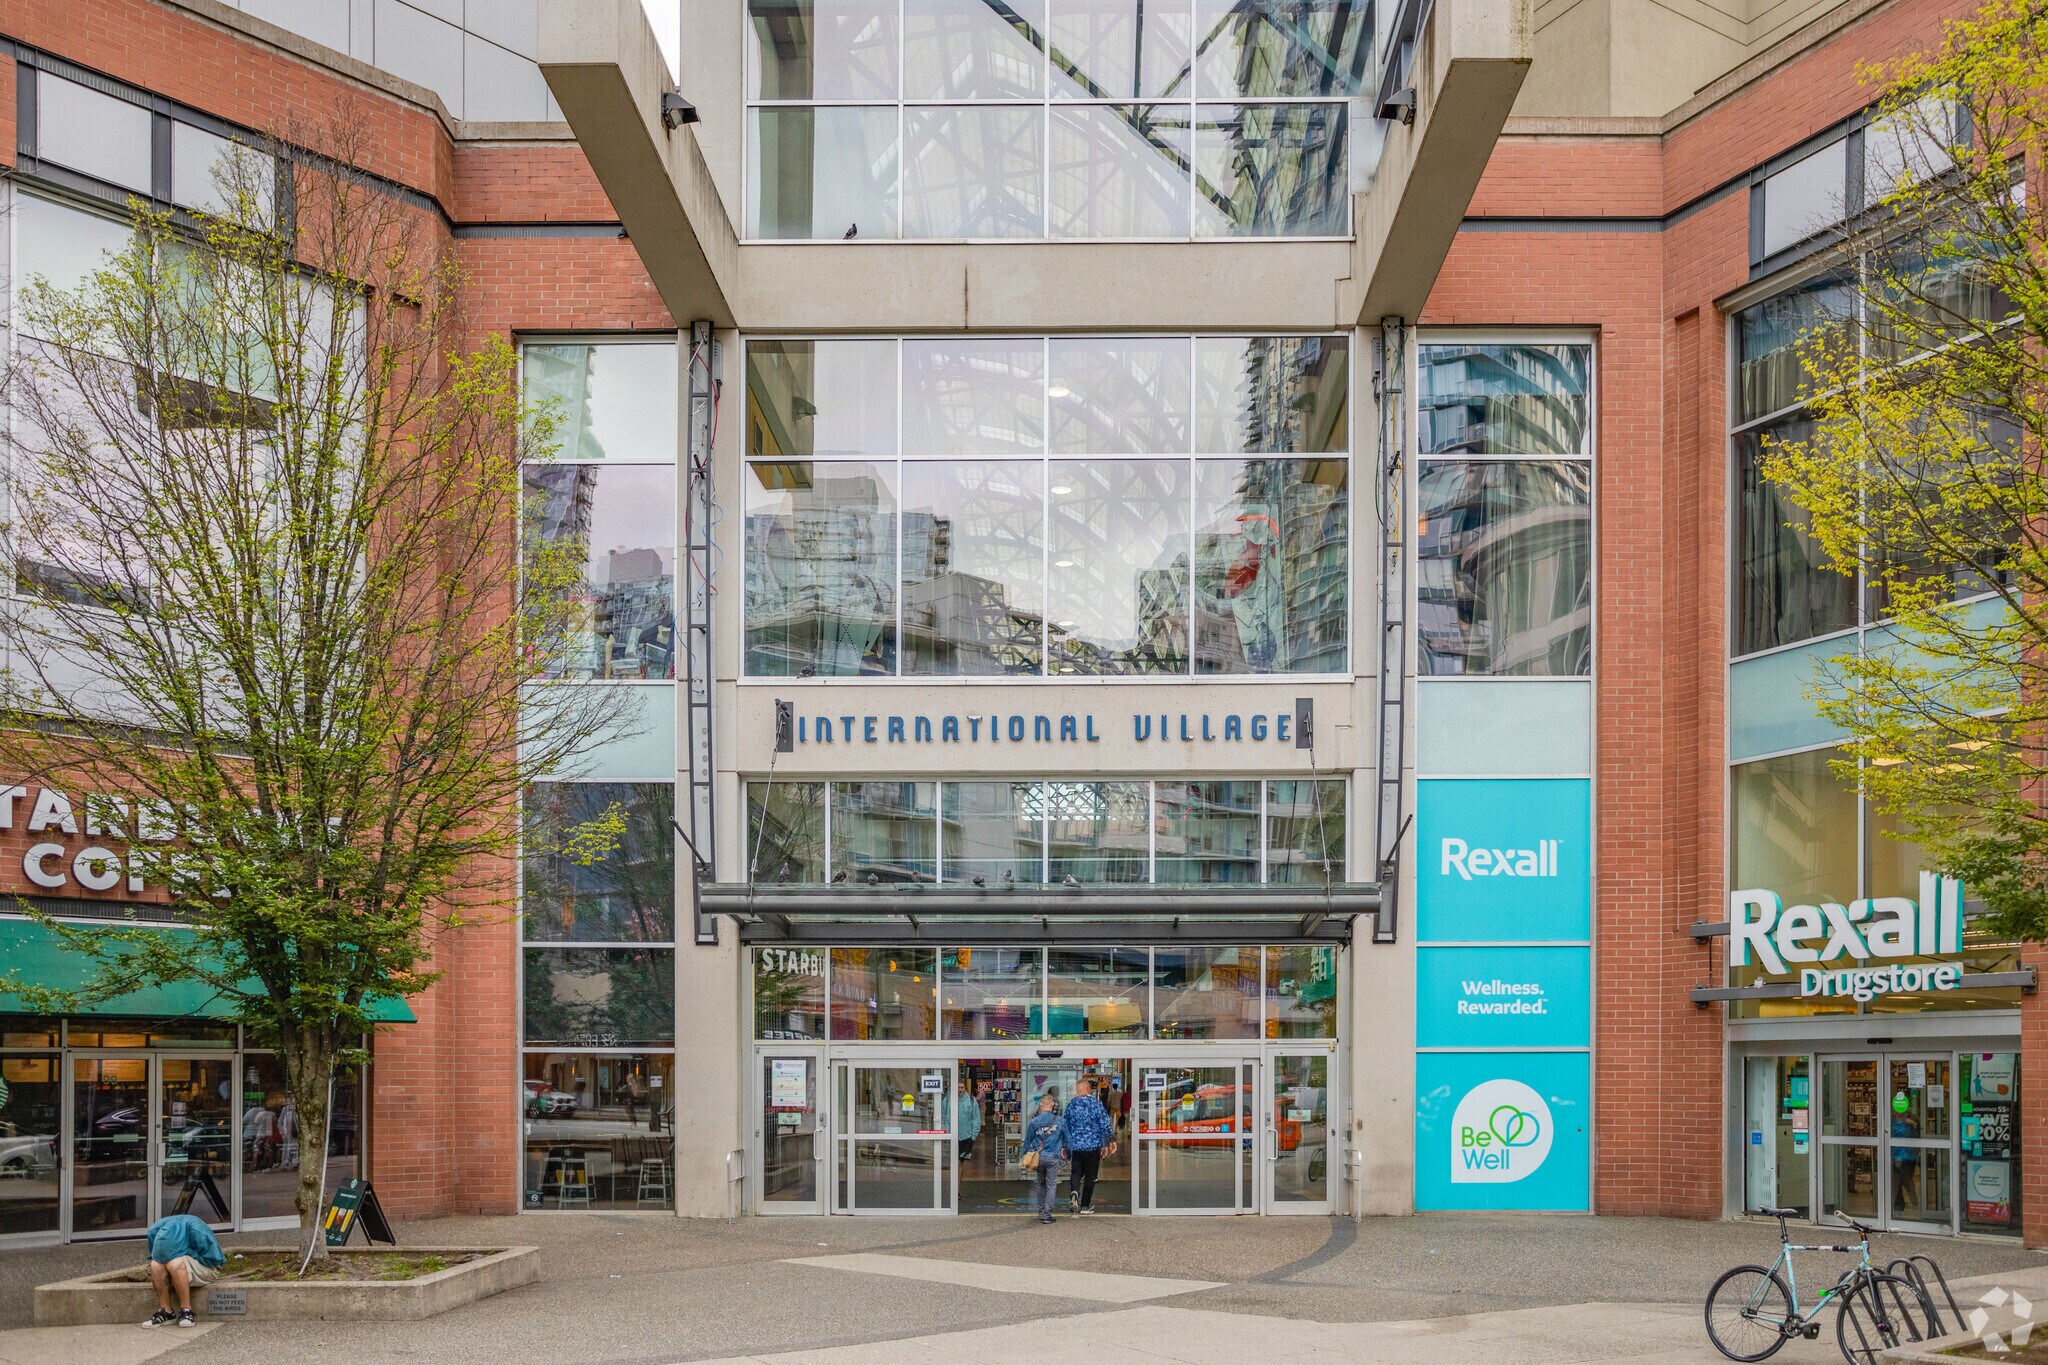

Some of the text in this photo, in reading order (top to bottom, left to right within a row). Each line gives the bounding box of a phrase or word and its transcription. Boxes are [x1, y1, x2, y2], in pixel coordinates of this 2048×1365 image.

[799, 713, 1291, 743] INTERNATIONAL VILLAGE
[1440, 838, 1558, 881] Rexall
[1730, 871, 1964, 975] Rexall
[1461, 980, 1544, 996] Wellness.
[1801, 962, 1962, 1002] Drugstore
[1457, 999, 1547, 1015] Rewarded.
[1973, 1113, 2009, 1127] AVE
[1461, 1126, 1492, 1148] Be
[1462, 1149, 1509, 1170] Well
